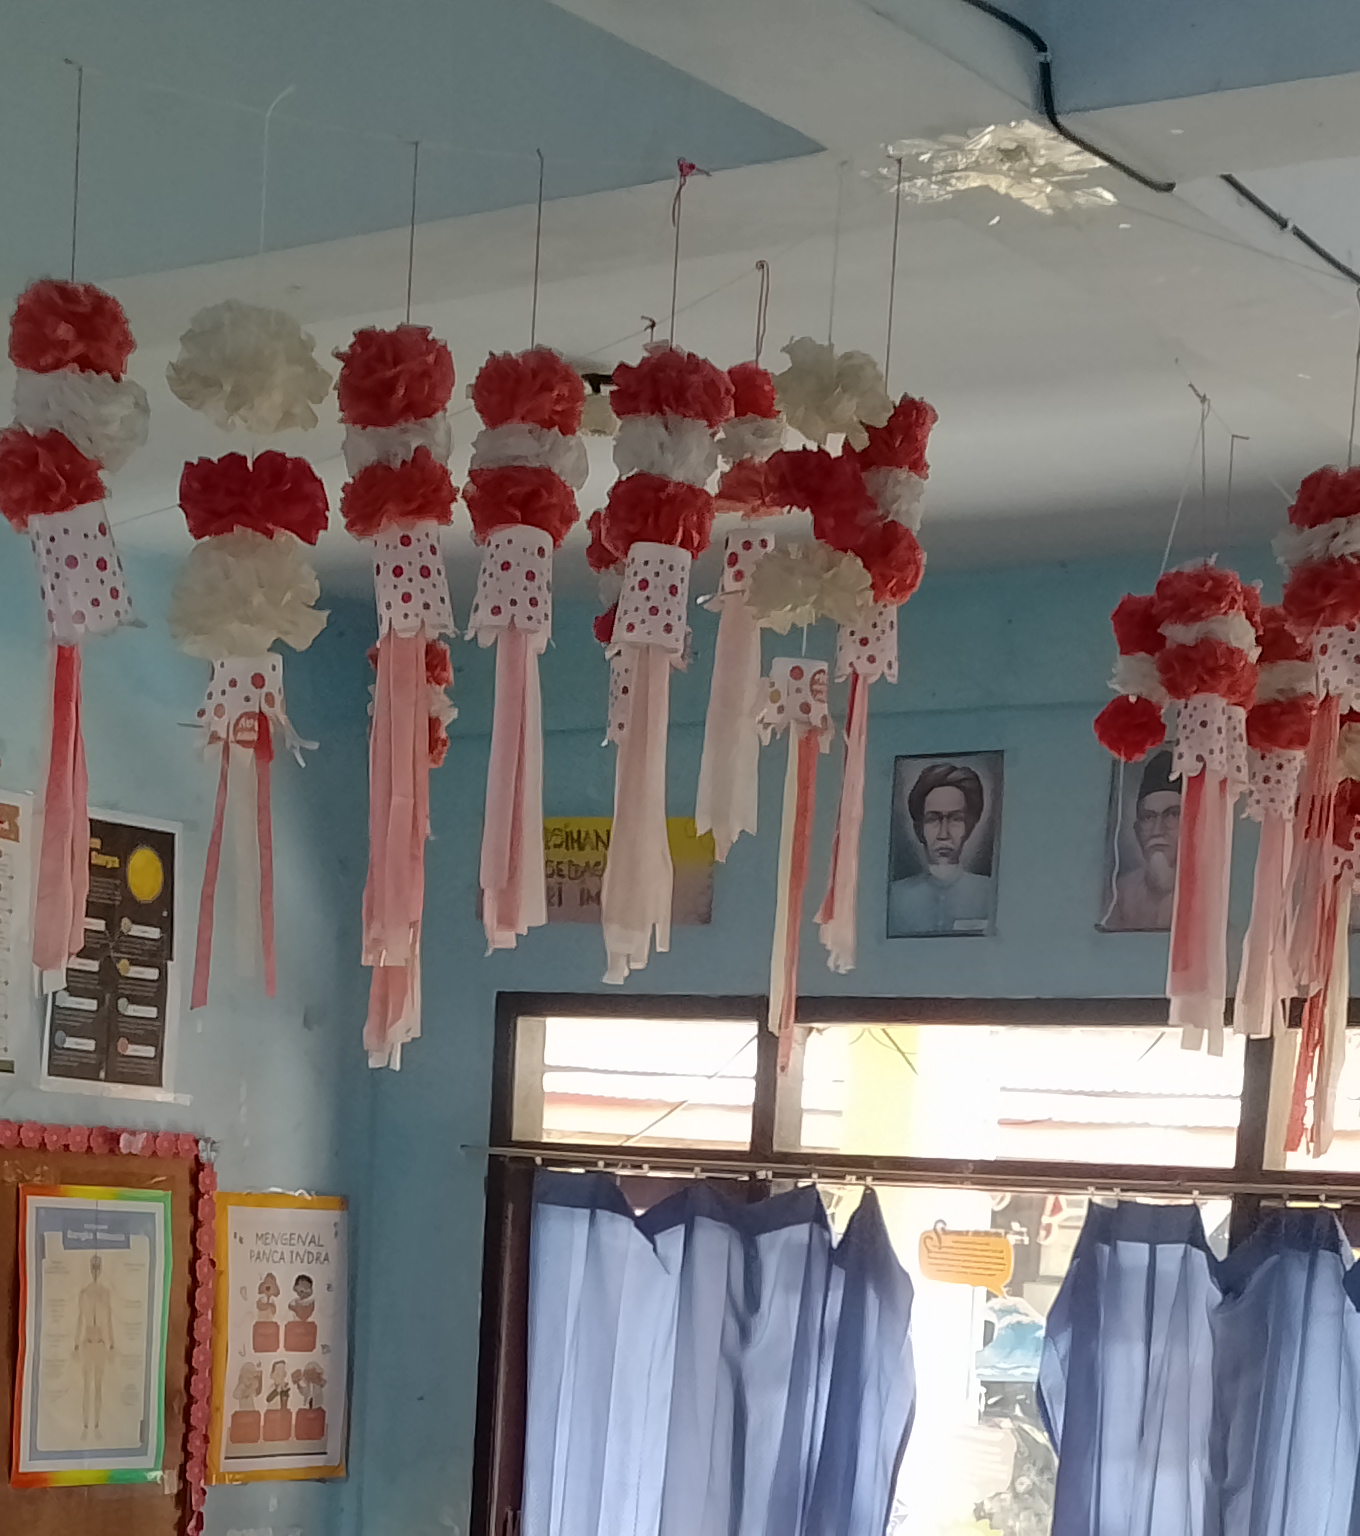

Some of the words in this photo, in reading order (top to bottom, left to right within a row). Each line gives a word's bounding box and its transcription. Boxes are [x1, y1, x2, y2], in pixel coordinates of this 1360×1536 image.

[255, 1231, 325, 1248] MENGENAL
[249, 1248, 286, 1264] PANCA
[289, 1248, 330, 1265] INDRA
